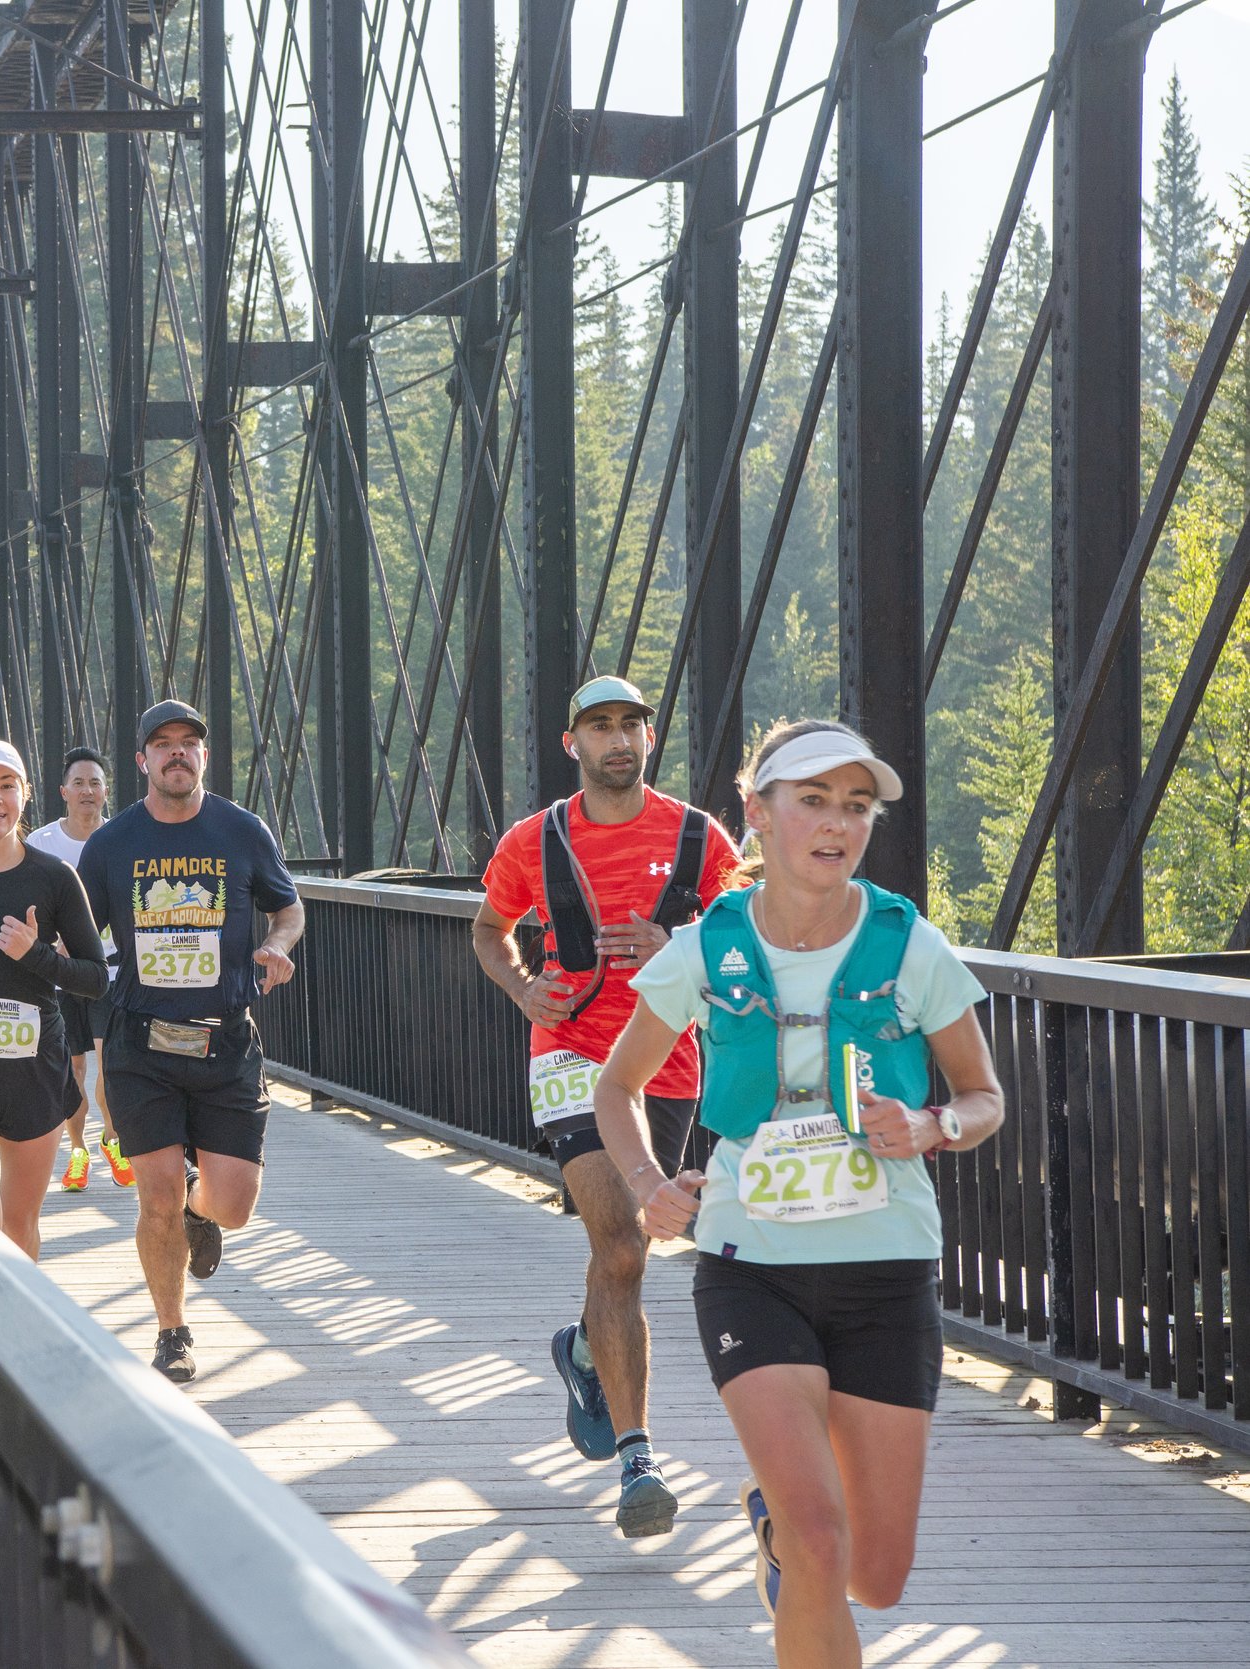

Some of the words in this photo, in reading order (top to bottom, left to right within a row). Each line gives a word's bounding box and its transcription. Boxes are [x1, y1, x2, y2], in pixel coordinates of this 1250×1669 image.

[133, 856, 227, 878] CANMORE
[134, 910, 168, 927] ROCKY
[170, 908, 225, 926] MOUNTAIN
[171, 935, 200, 944] CANMORE
[141, 952, 216, 977] 2378
[553, 1052, 591, 1066] CANMO
[793, 1118, 847, 1140] CANMOR
[746, 1147, 878, 1203] 2279
